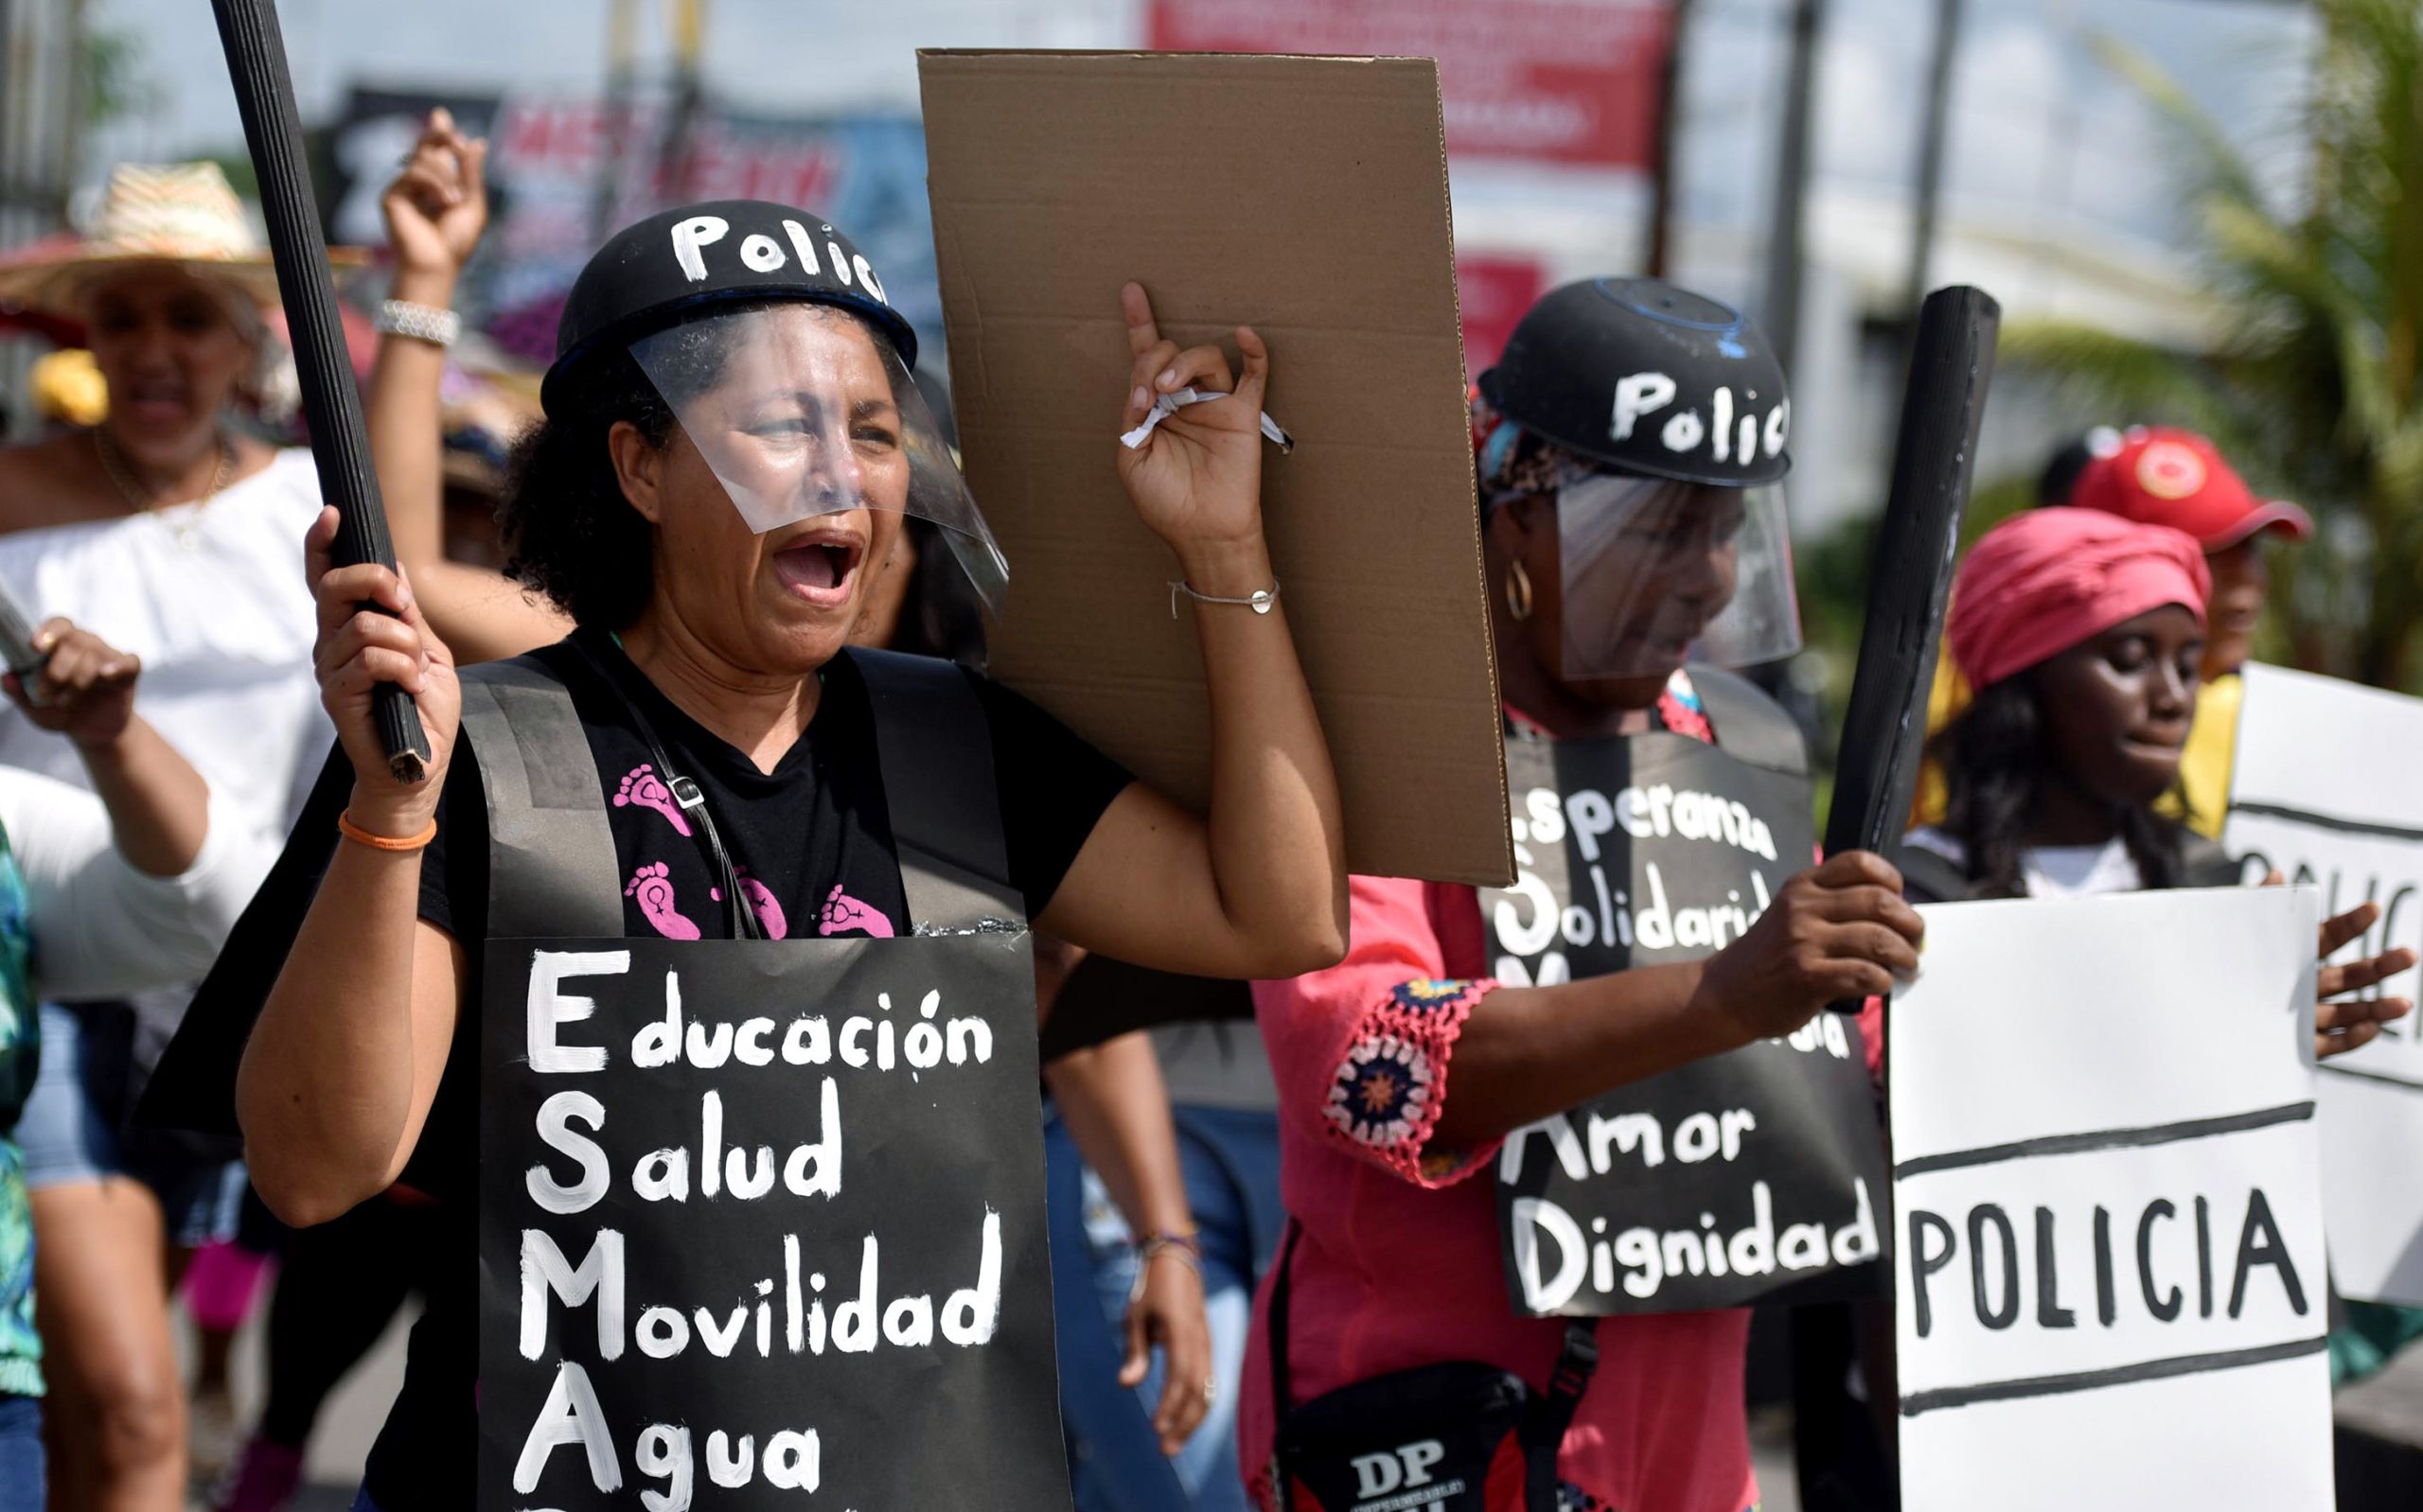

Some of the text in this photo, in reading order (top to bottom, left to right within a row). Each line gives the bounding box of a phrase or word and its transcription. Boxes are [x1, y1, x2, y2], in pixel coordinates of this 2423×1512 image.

[525, 949, 994, 1074] Educación
[525, 1076, 841, 1214] Salud
[1499, 1109, 1756, 1185] Amor
[519, 1201, 1003, 1361] Movilidad
[1512, 1177, 1880, 1312] Dignidad
[1908, 1188, 2308, 1338] POLICIA
[512, 1361, 822, 1512] Agua
[1350, 1438, 1444, 1500] DP
